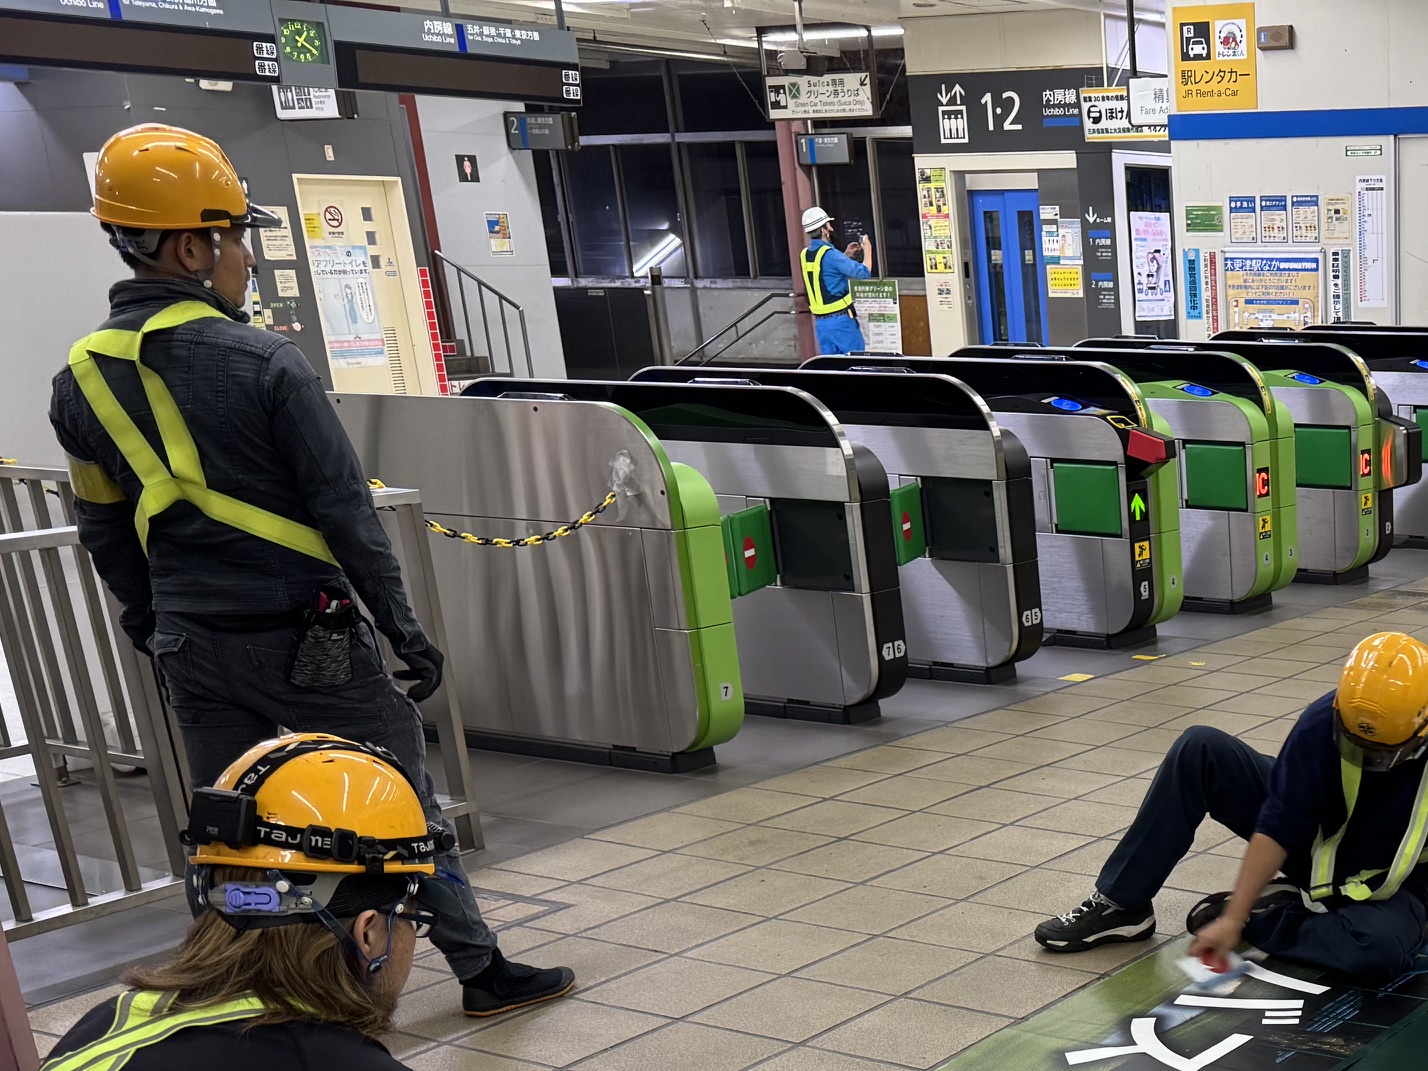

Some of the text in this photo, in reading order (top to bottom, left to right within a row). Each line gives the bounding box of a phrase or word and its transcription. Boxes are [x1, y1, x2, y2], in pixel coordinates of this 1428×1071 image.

[423, 20, 453, 35] 内房線
[443, 35, 455, 44] Line
[254, 43, 276, 56] 番線
[257, 61, 278, 76] 番線
[1180, 68, 1251, 87] 駅レンタカー
[805, 87, 861, 99] グリーン券うりば
[1042, 88, 1078, 105] 内房線
[1182, 88, 1240, 99] JR Rent-a-Car
[837, 99, 852, 107] (Suica
[852, 99, 866, 107] Only)
[1065, 106, 1080, 115] Line
[1140, 106, 1158, 115] Fare
[509, 117, 519, 134] 2
[800, 138, 806, 152] 1
[1225, 259, 1280, 272] 木更津駅なか
[1359, 453, 1371, 475] IC
[1255, 472, 1269, 496] IC
